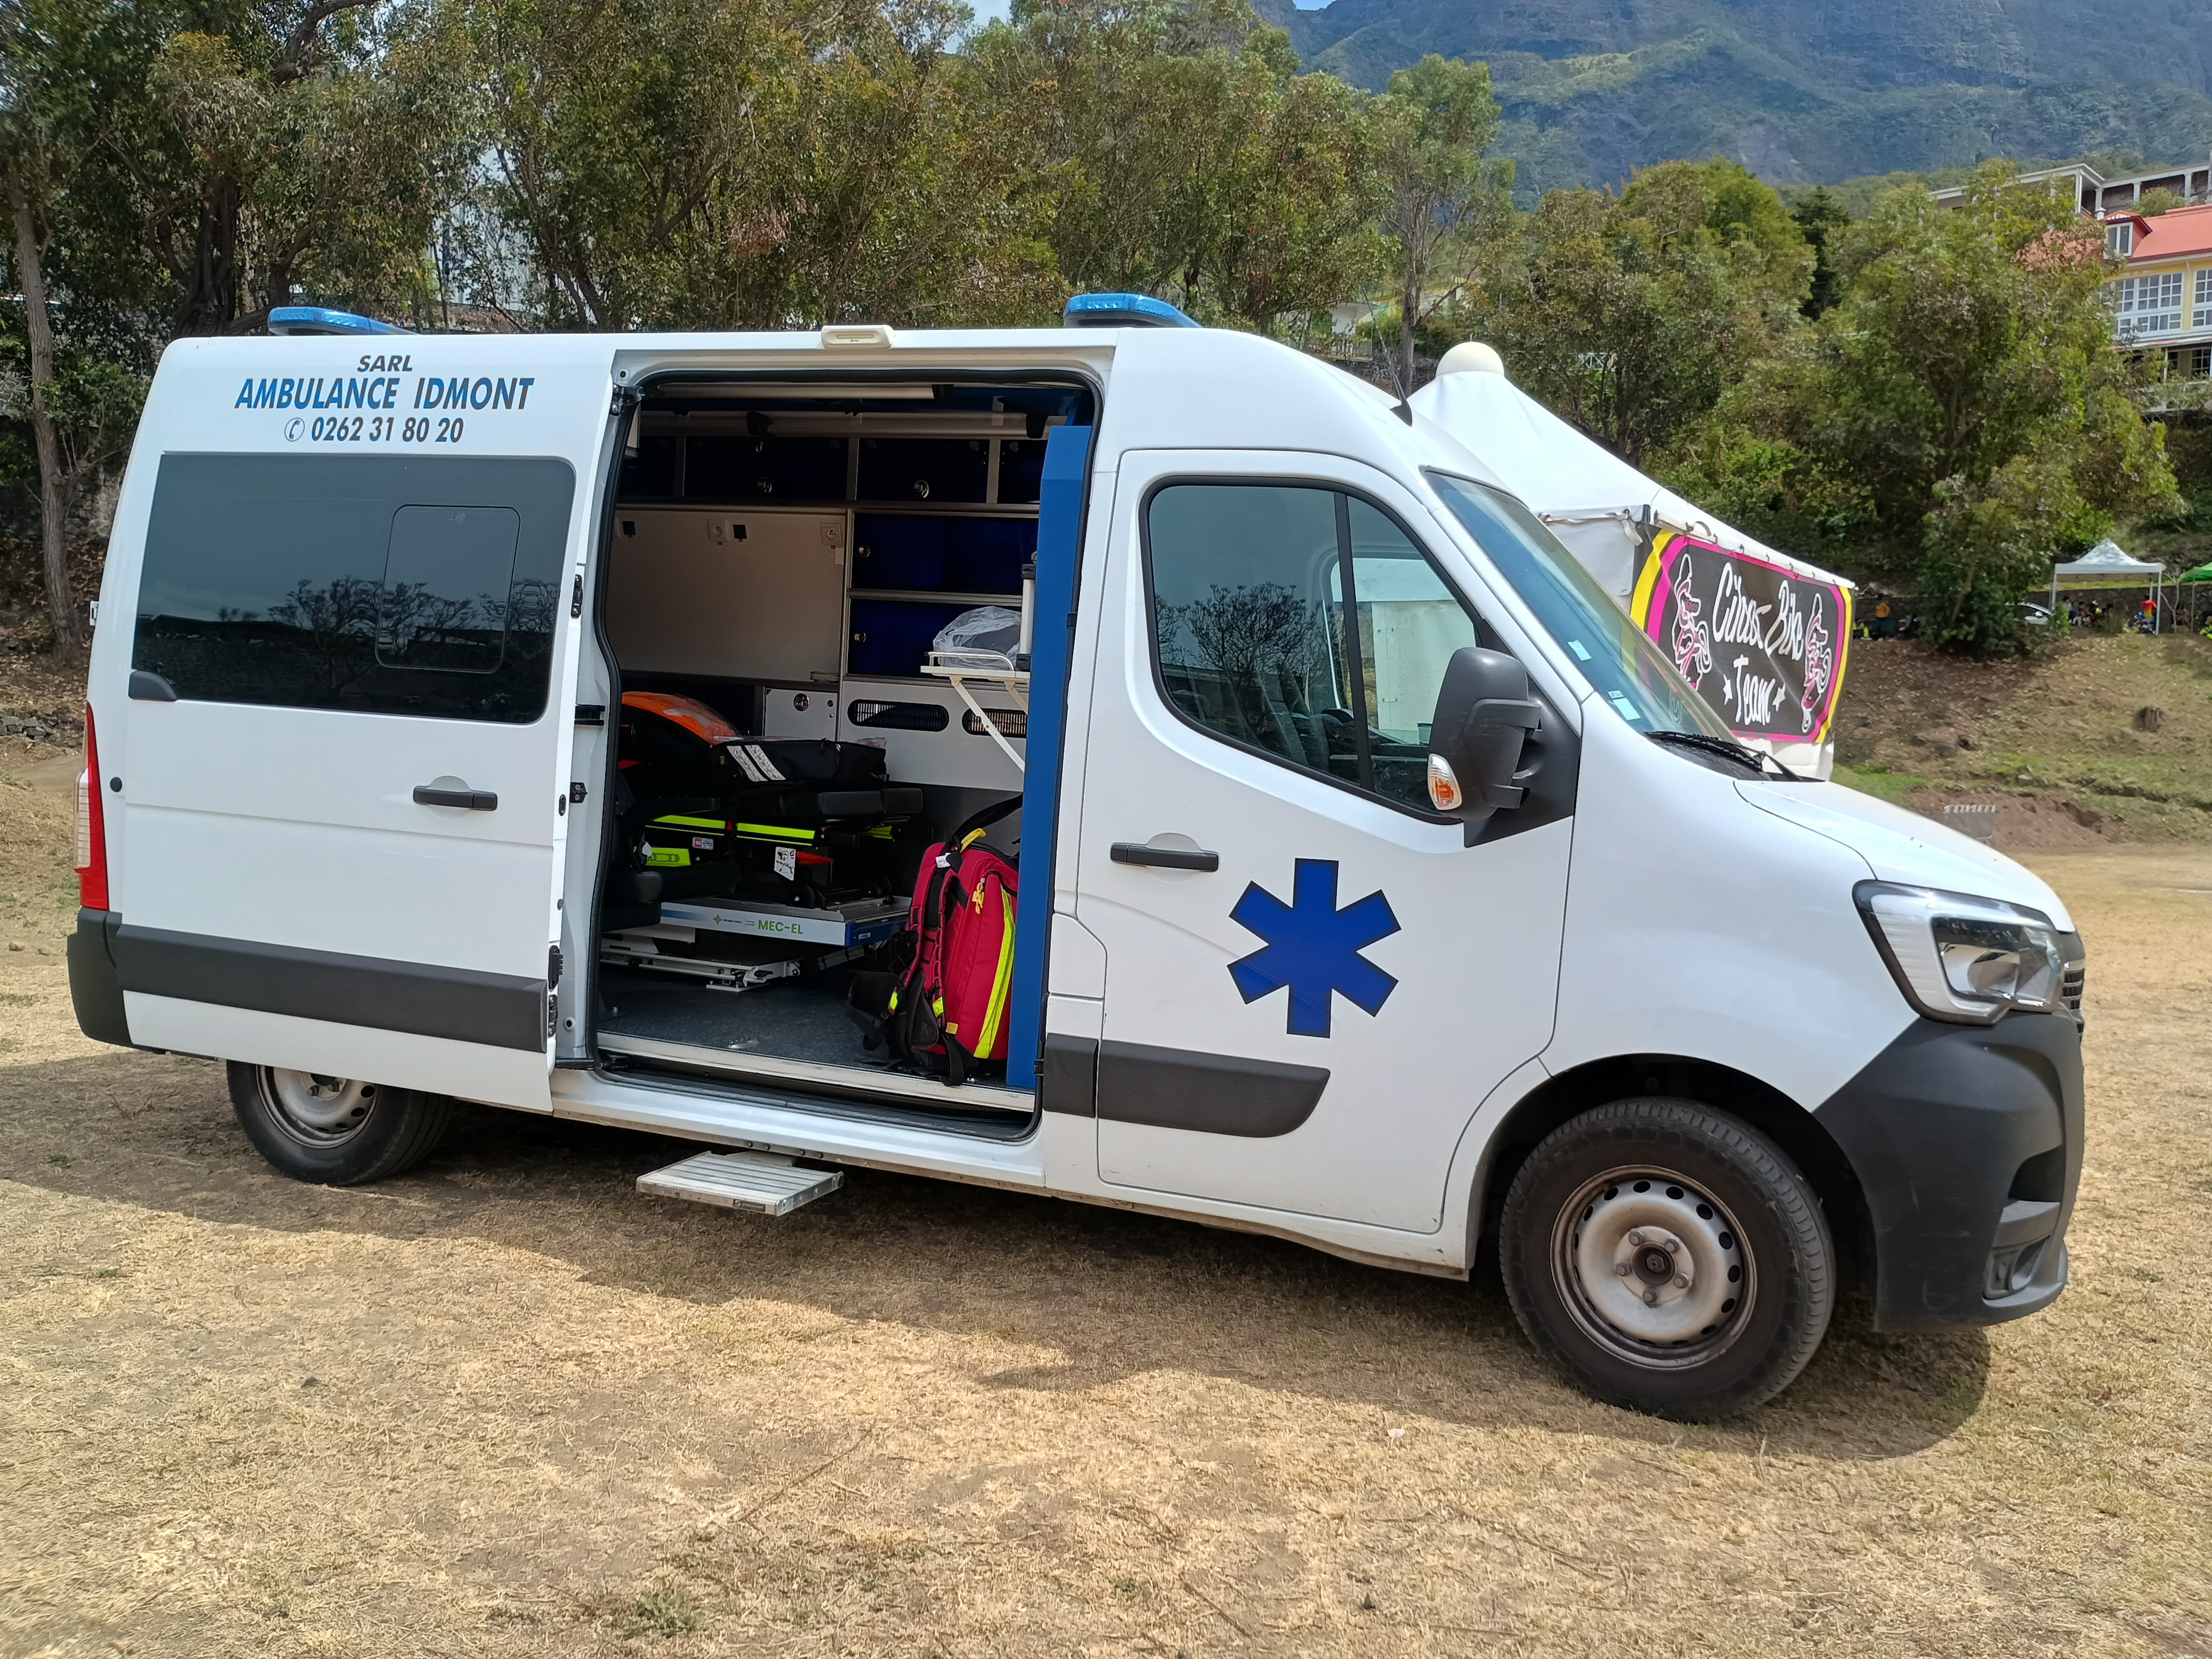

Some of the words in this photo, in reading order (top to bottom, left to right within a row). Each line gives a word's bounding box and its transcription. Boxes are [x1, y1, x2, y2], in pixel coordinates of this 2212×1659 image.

[357, 355, 413, 372] SARL
[234, 377, 400, 409] AMBULANCE
[414, 377, 535, 410] IDMONT
[311, 416, 363, 441] 0262
[369, 417, 394, 441] 31
[402, 417, 429, 442] 80
[435, 417, 464, 443] 20
[1764, 580, 1804, 661] Bike
[1733, 654, 1776, 725] Team
[758, 919, 803, 935] MEC-EL
